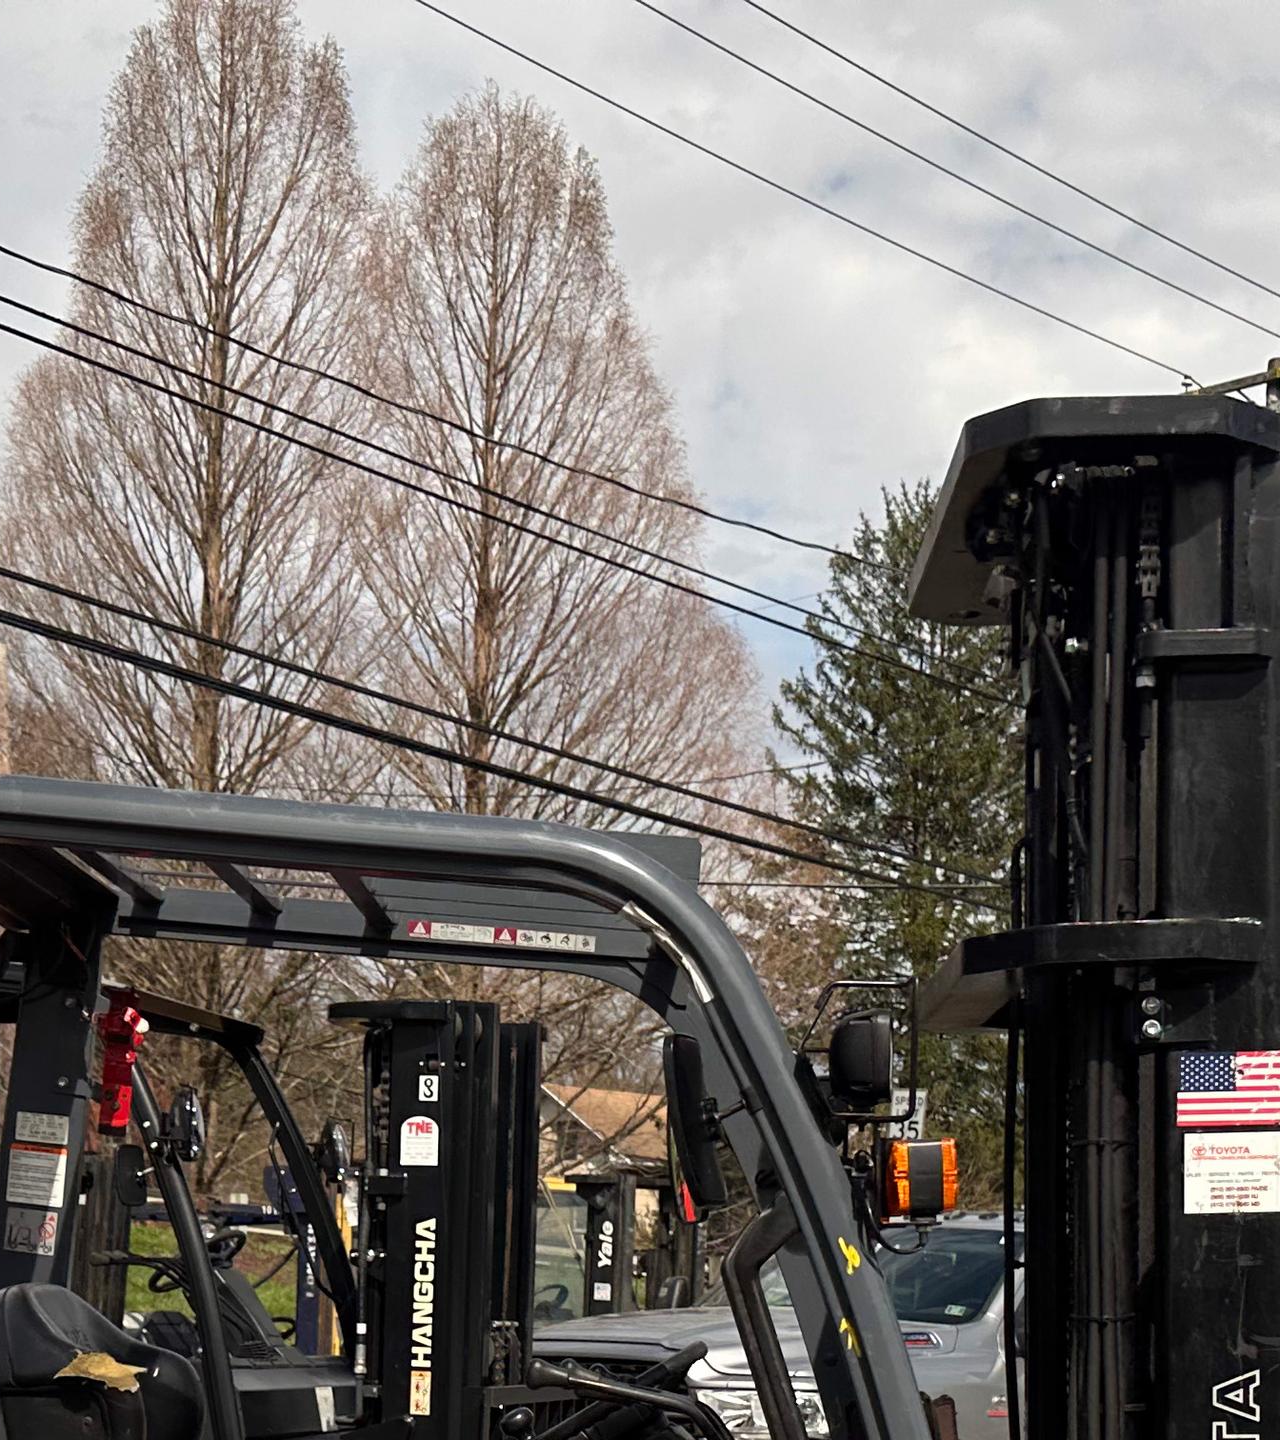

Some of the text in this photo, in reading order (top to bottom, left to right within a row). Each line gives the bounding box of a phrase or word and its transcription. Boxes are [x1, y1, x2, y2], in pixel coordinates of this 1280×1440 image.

[894, 1096, 924, 1106] SPD
[894, 1120, 919, 1140] 35
[1210, 1146, 1250, 1155] TOYOTA
[597, 1221, 614, 1268] Yale
[410, 1217, 437, 1368] HANGCHA
